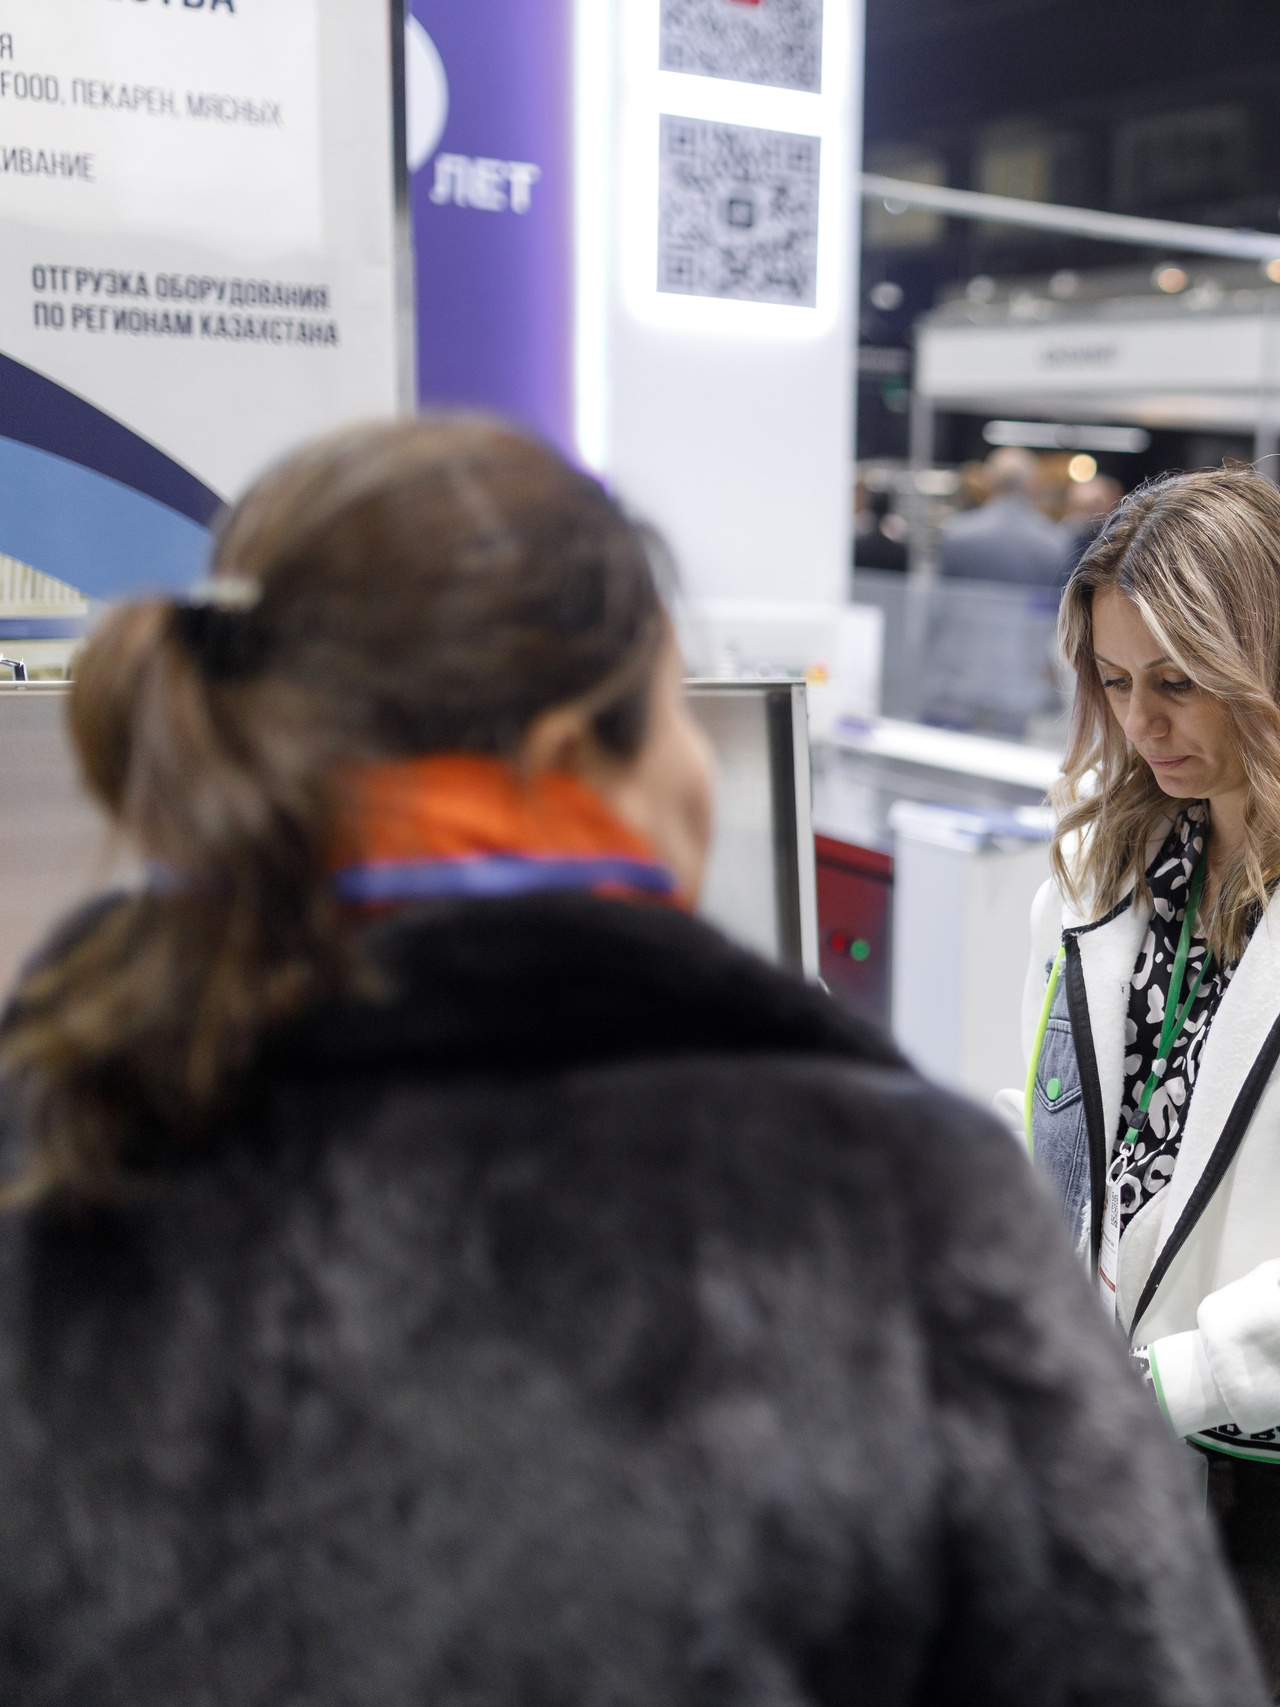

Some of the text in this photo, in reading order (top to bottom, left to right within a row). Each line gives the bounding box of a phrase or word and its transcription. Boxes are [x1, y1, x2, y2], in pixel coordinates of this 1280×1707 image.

[0, 148, 96, 182] ИВАНИЕ
[430, 153, 542, 214] ЛЕТ
[32, 264, 330, 311] ОТГРУЗКА ОБОРУДОВАНИЯ
[34, 302, 341, 347] ПО РЕГИОНАМ КАЗАХСТАНА
